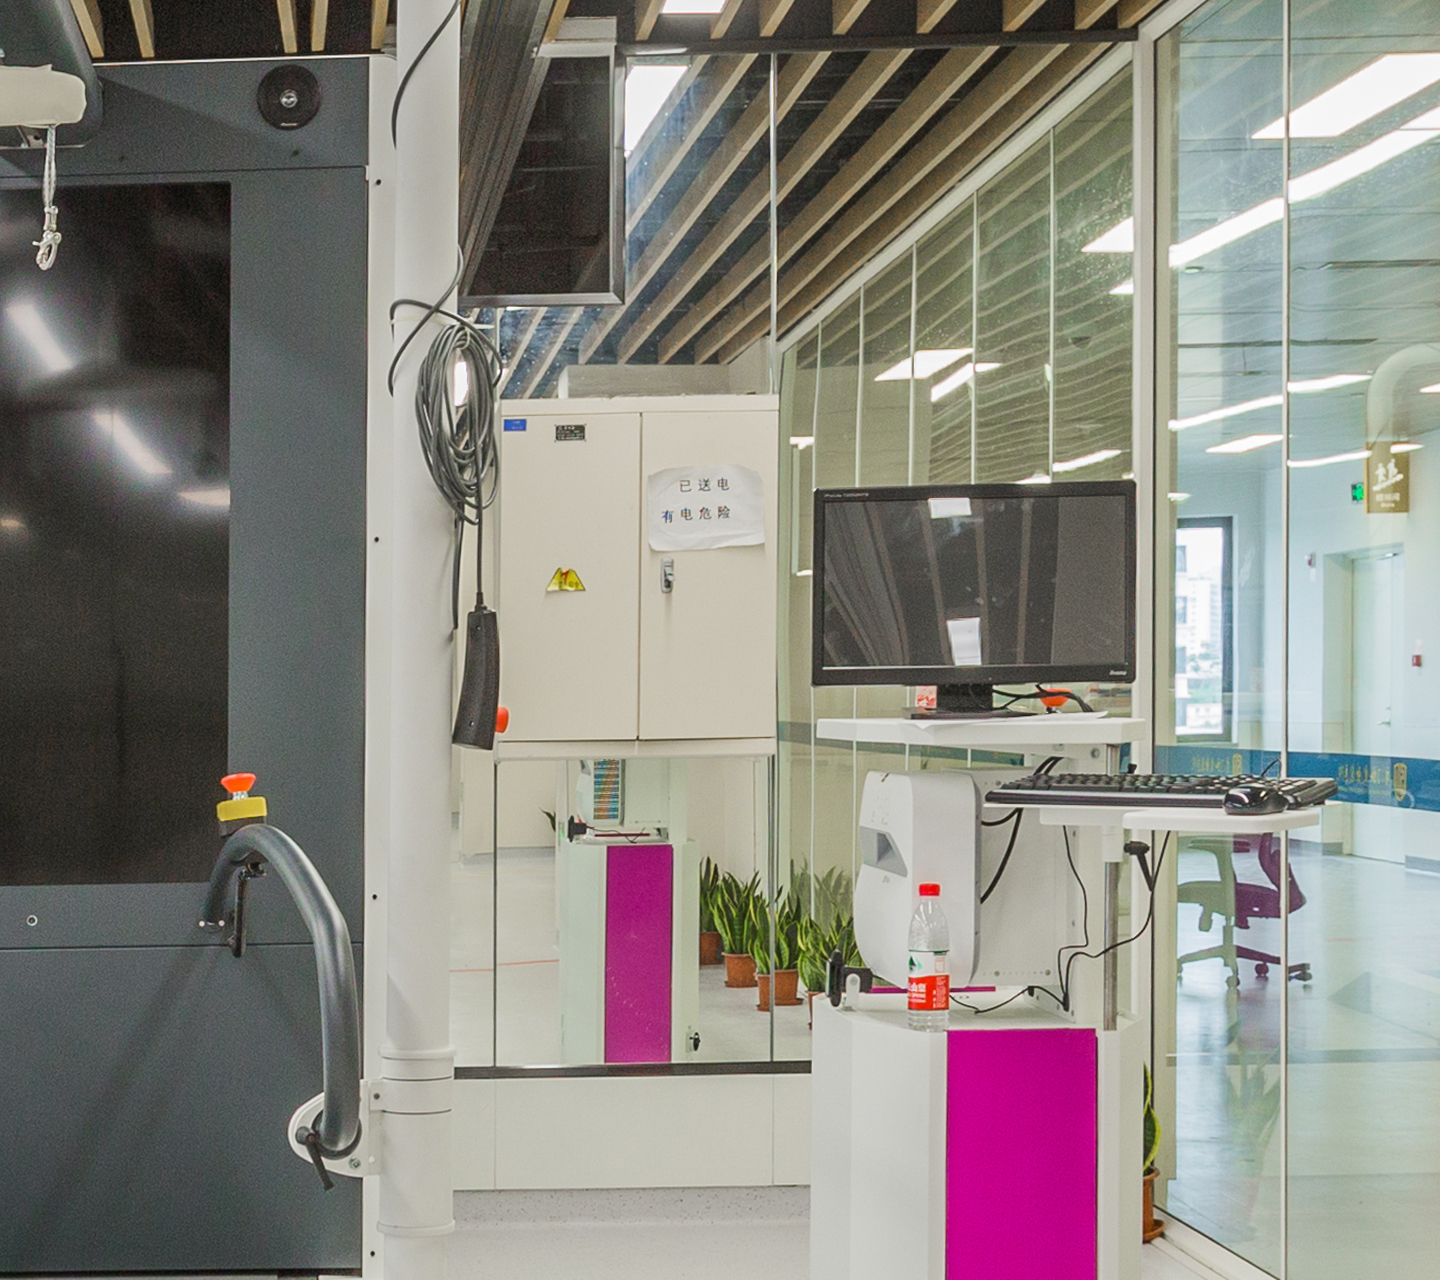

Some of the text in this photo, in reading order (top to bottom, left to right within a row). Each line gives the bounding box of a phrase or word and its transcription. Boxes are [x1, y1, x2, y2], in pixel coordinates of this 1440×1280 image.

[679, 477, 731, 493] 已送电
[661, 505, 731, 524] 有电危险
